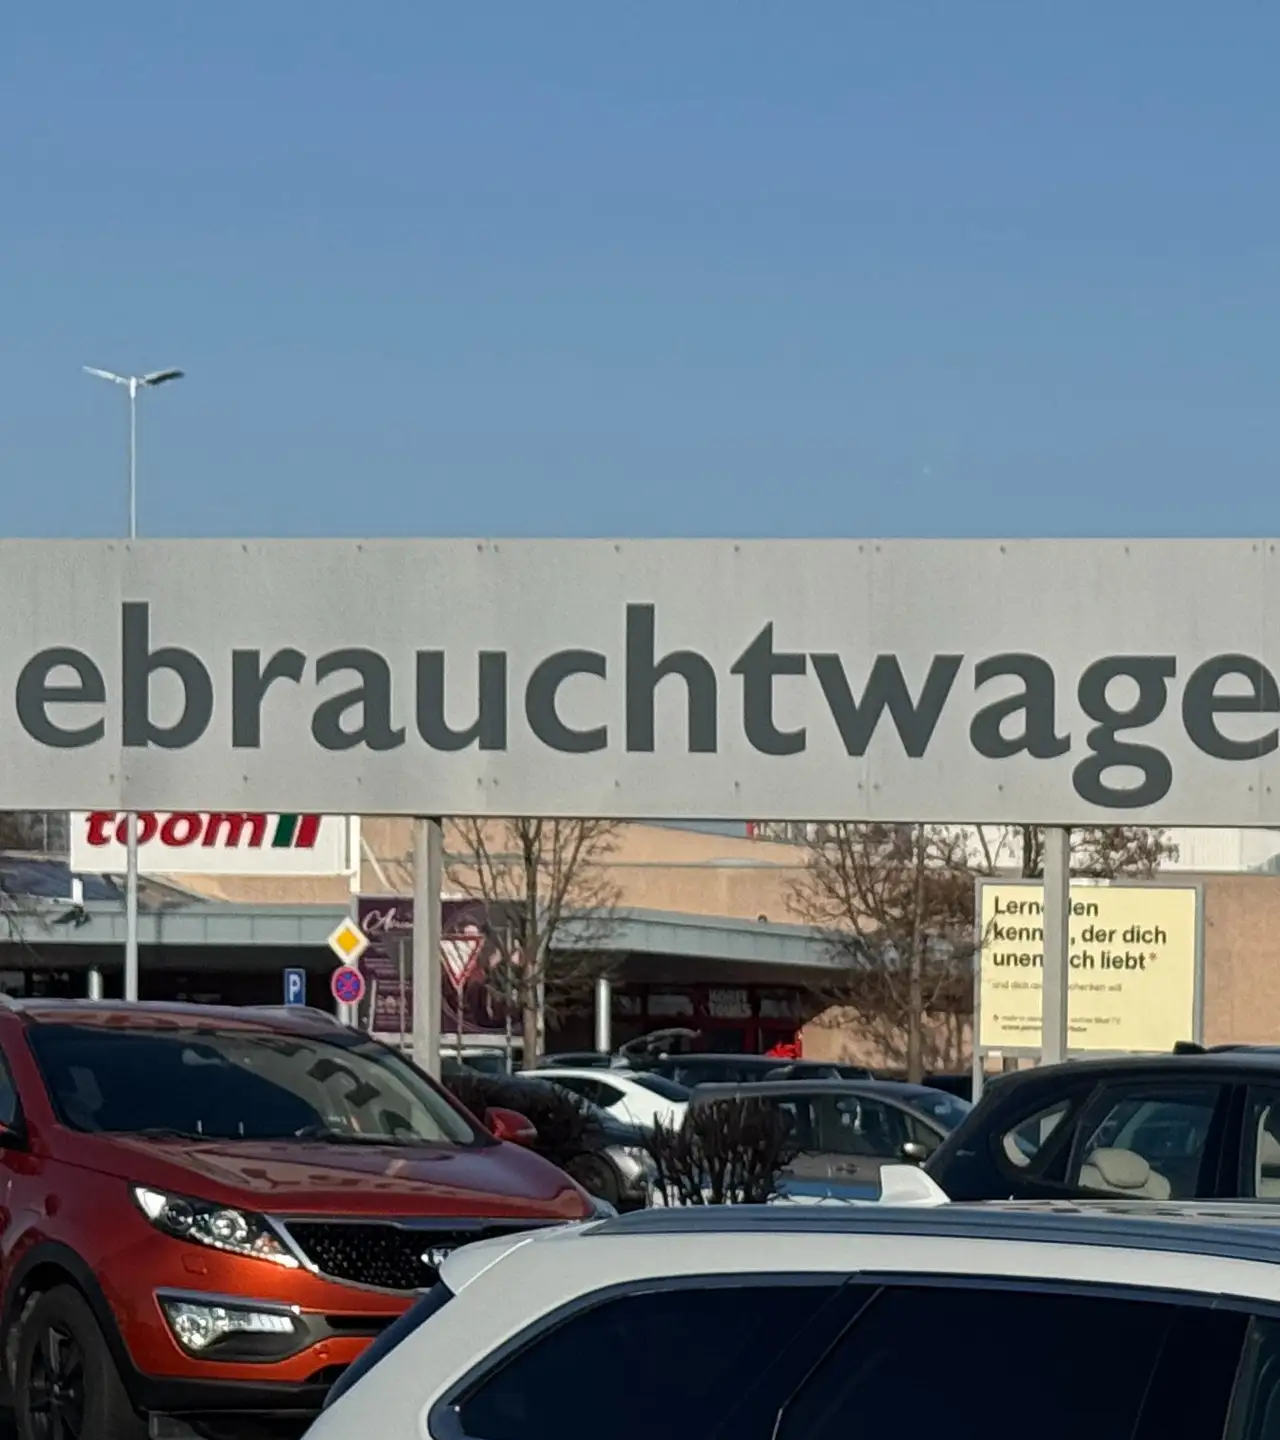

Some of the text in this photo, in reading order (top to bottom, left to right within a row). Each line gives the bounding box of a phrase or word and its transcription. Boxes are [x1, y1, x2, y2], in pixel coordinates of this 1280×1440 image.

[85, 812, 268, 848] toom
[1081, 925, 1116, 943] der
[1122, 925, 1167, 944] dich
